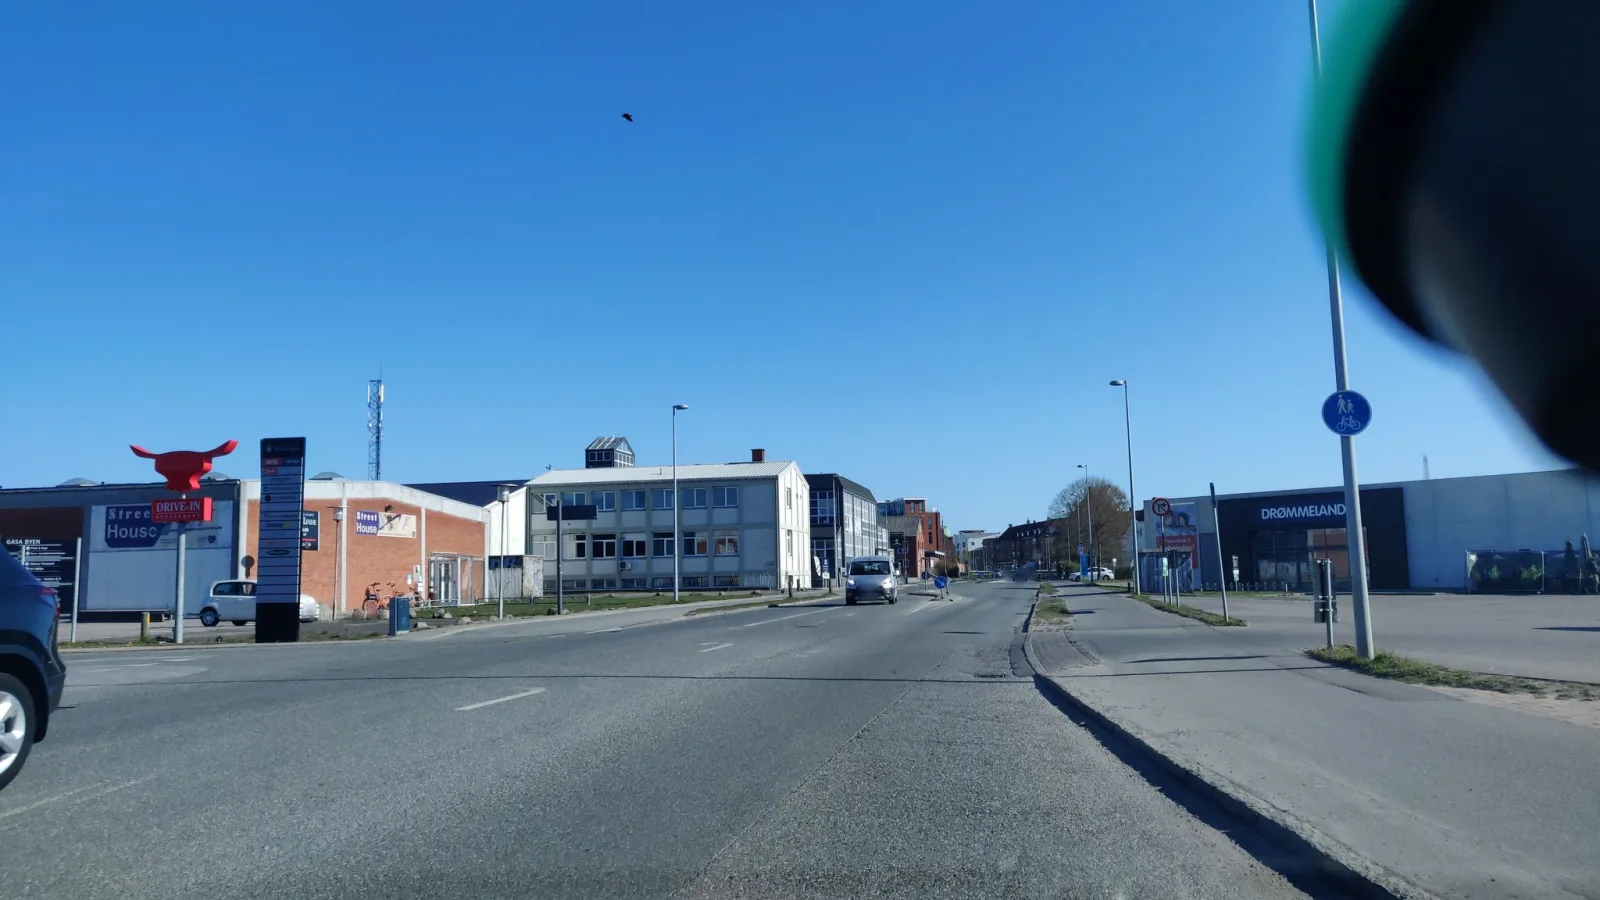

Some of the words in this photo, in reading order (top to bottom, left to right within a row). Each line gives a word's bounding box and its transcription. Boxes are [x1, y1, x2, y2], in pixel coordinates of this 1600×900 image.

[156, 501, 200, 512] DRIVE-IN
[1261, 503, 1347, 519] DRØMMELAND
[108, 508, 151, 519] Stree
[356, 511, 378, 521] Street
[107, 524, 157, 538] House
[356, 522, 378, 534] House
